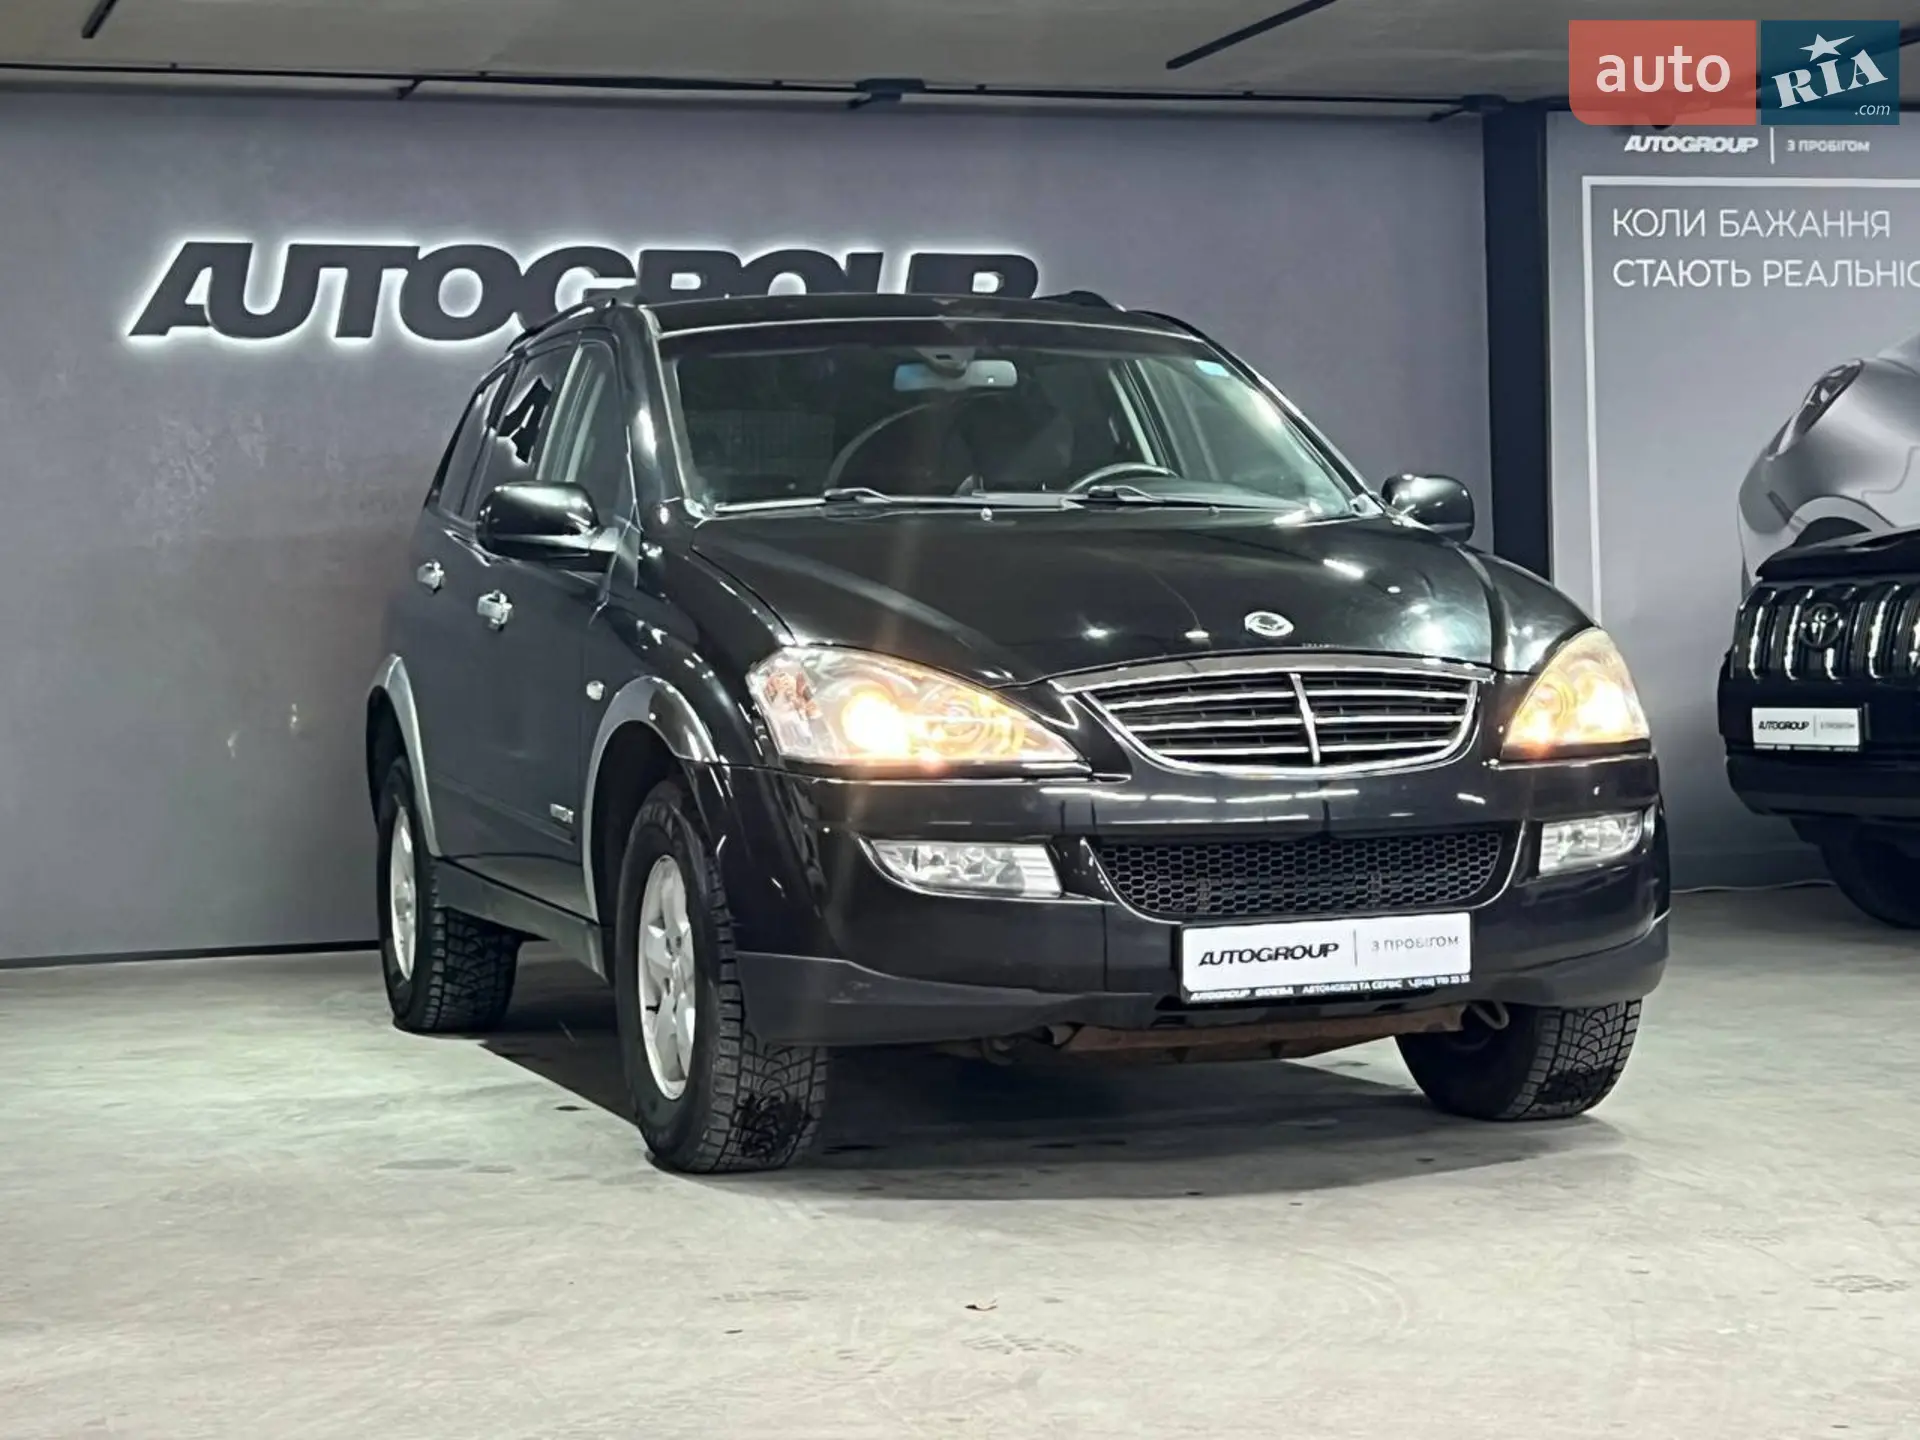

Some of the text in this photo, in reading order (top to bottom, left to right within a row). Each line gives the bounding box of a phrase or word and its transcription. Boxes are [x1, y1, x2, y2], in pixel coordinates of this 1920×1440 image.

[1624, 135, 1759, 154] AUTOGROUP
[1612, 208, 1891, 239] КОЛИ БАЖАННЯ
[1612, 259, 1752, 288] СТАЮТЬ
[1198, 943, 1340, 967] AUTOGROUP
